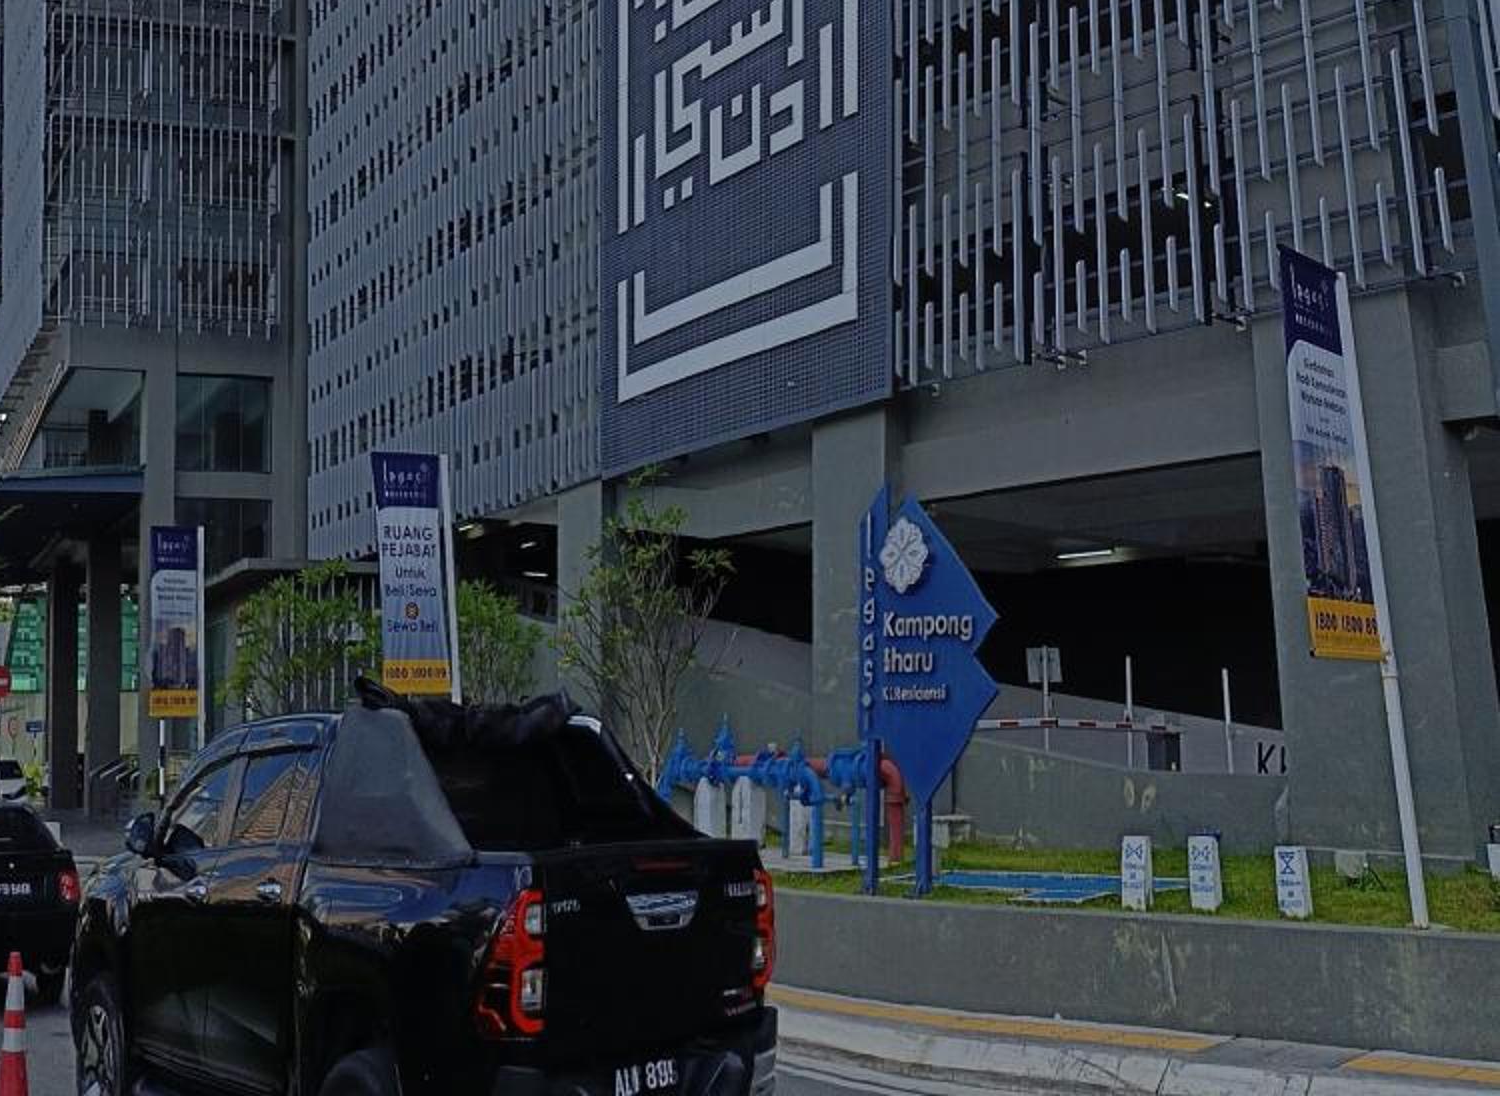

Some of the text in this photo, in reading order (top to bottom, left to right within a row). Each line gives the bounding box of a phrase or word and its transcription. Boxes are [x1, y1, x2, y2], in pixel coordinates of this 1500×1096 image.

[383, 525, 434, 541] RUANG
[382, 542, 437, 558] PEJABAT
[883, 611, 973, 641] Kampong
